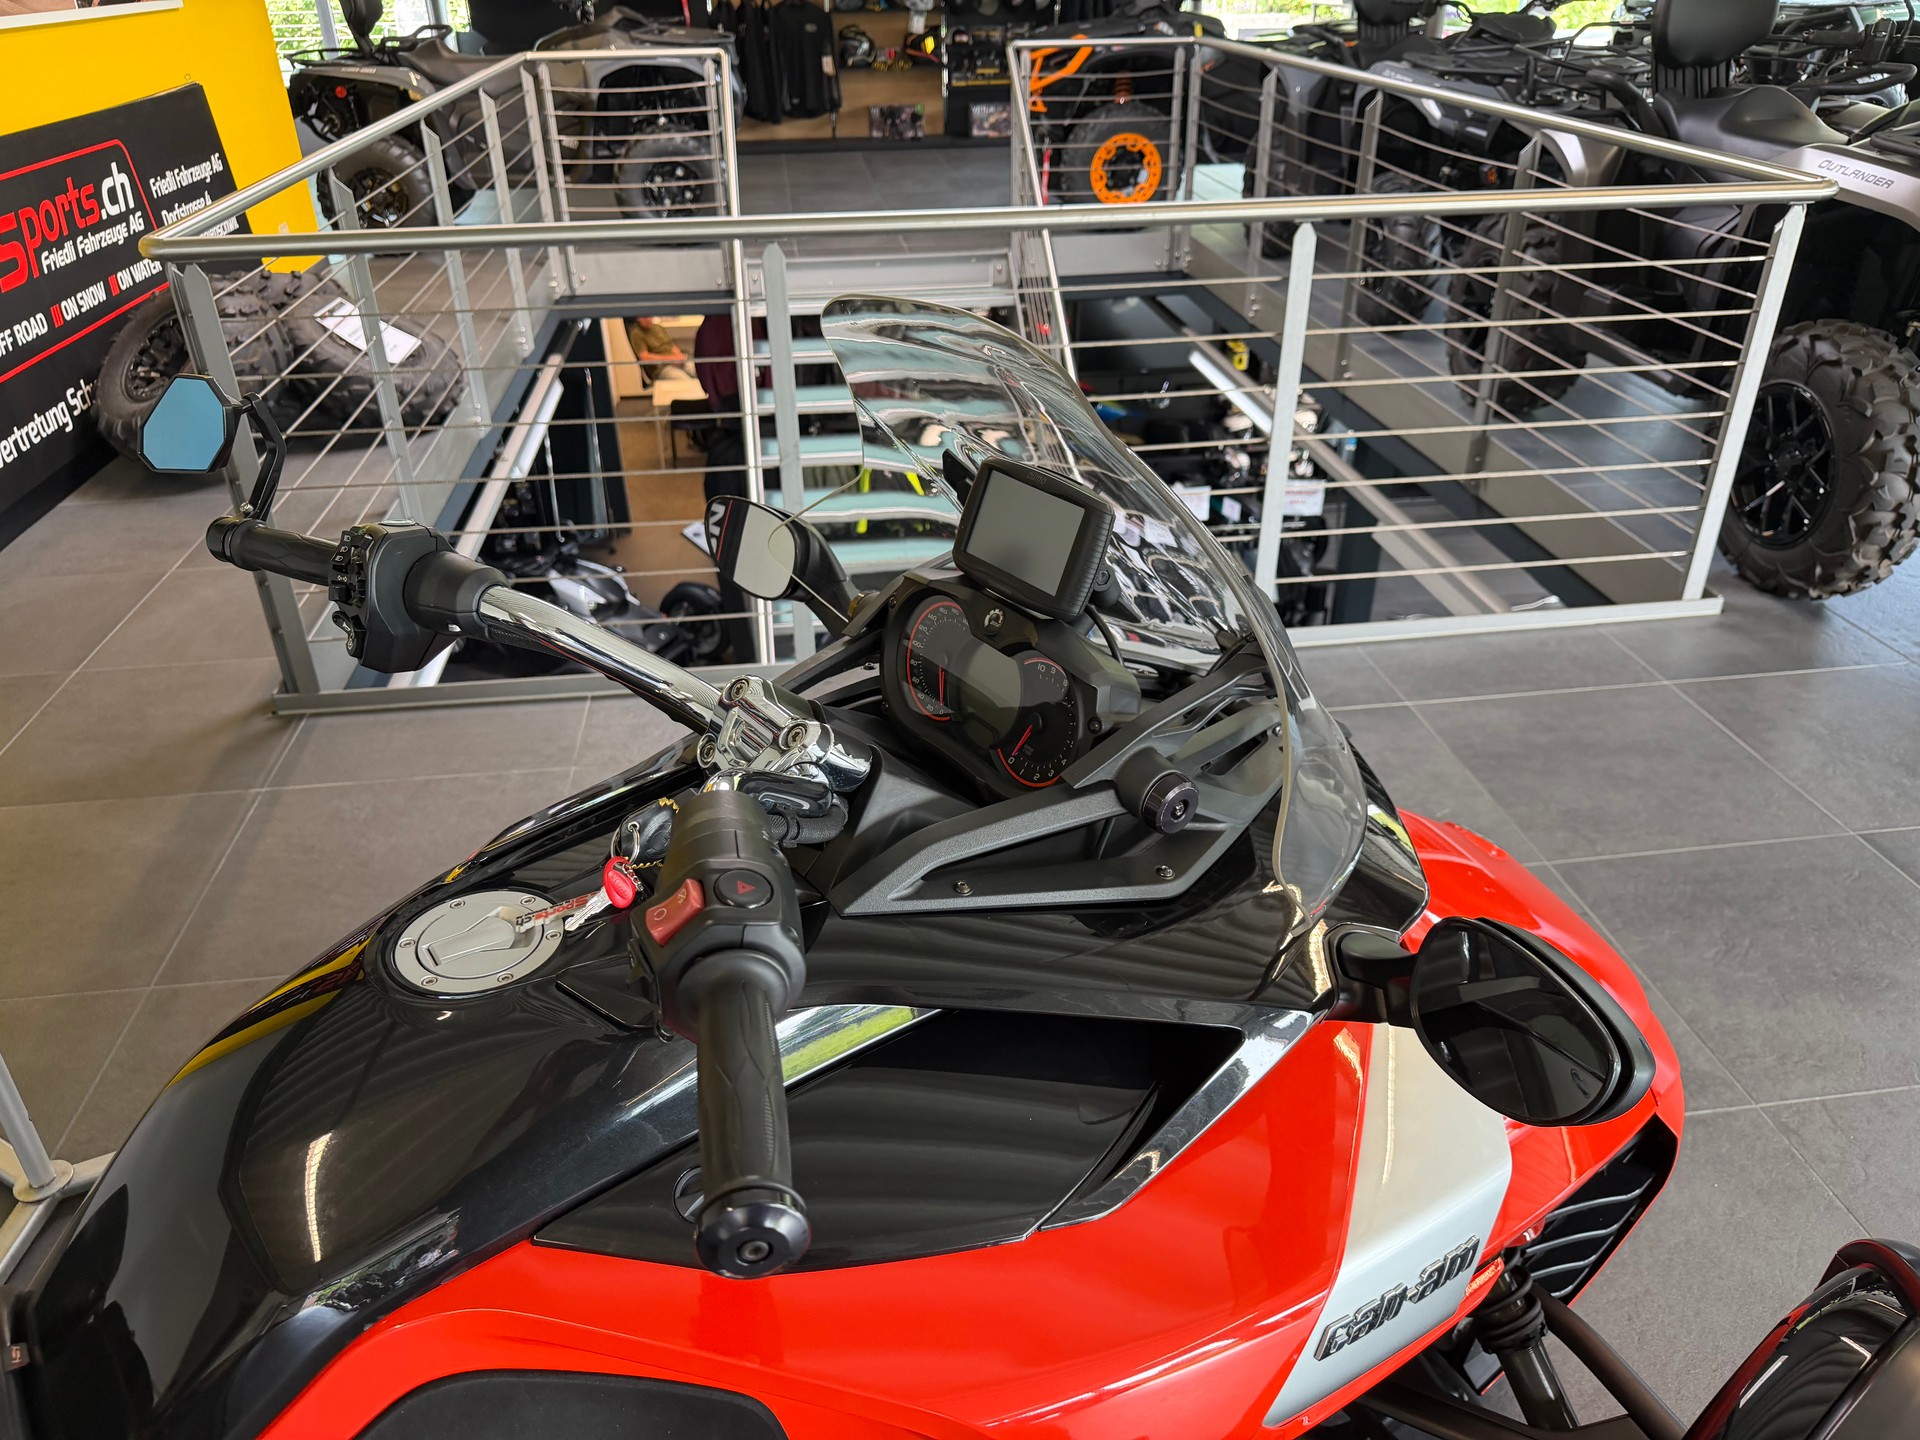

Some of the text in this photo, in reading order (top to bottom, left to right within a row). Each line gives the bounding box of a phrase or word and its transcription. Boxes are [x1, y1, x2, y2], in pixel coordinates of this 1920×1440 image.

[149, 152, 224, 199] Friedli Fahrzeuge AG
[1817, 159, 1895, 189] OUTLANDER
[0, 161, 135, 294] Sports.ch
[41, 210, 145, 275] Friedli Fahrzeuge AG
[0, 257, 163, 358] FF ROAD ON SNOW ON WATER
[66, 378, 97, 416] Sch
[1037, 663, 1046, 672] 10
[1050, 666, 1056, 675] 9
[1062, 679, 1068, 687] 8
[1007, 756, 1015, 765] 0
[1061, 758, 1067, 766] 4
[1032, 773, 1040, 781] 2
[1047, 769, 1055, 777] 3
